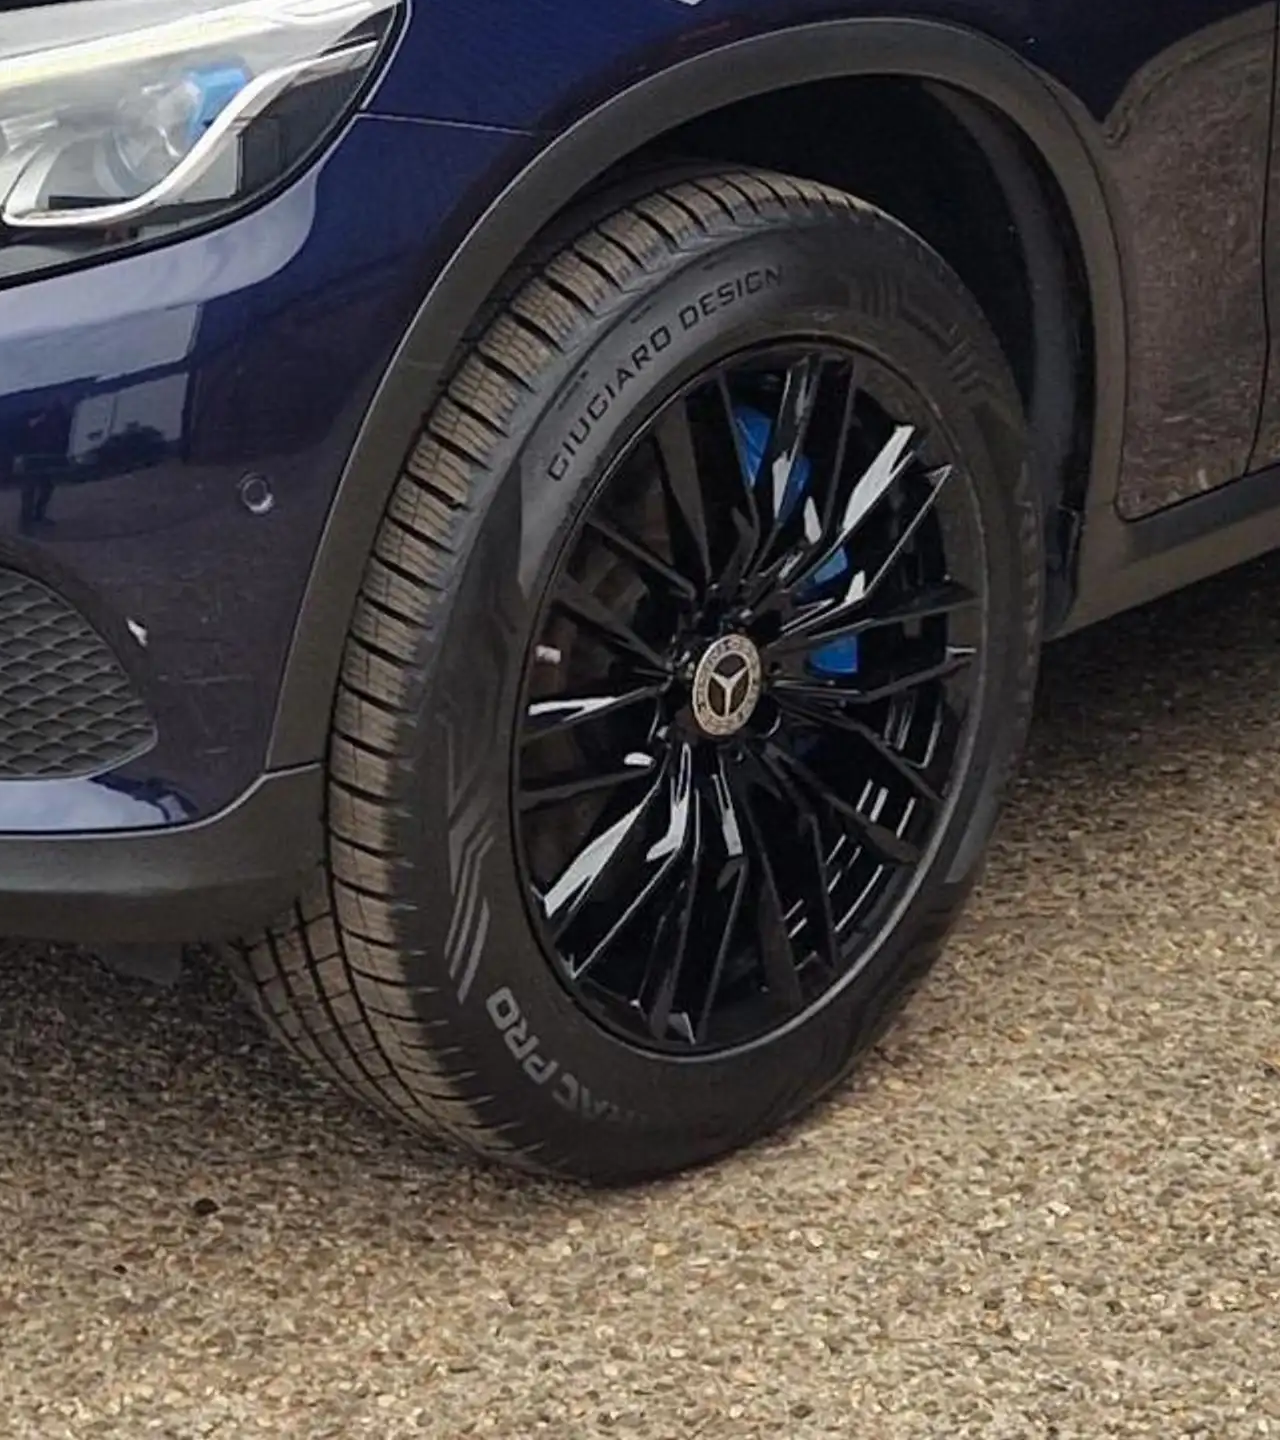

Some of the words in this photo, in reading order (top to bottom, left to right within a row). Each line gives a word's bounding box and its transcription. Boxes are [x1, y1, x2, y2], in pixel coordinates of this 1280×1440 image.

[547, 325, 672, 483] GIUGIARO
[678, 263, 783, 332] DESIGN
[485, 985, 559, 1086] PRO
